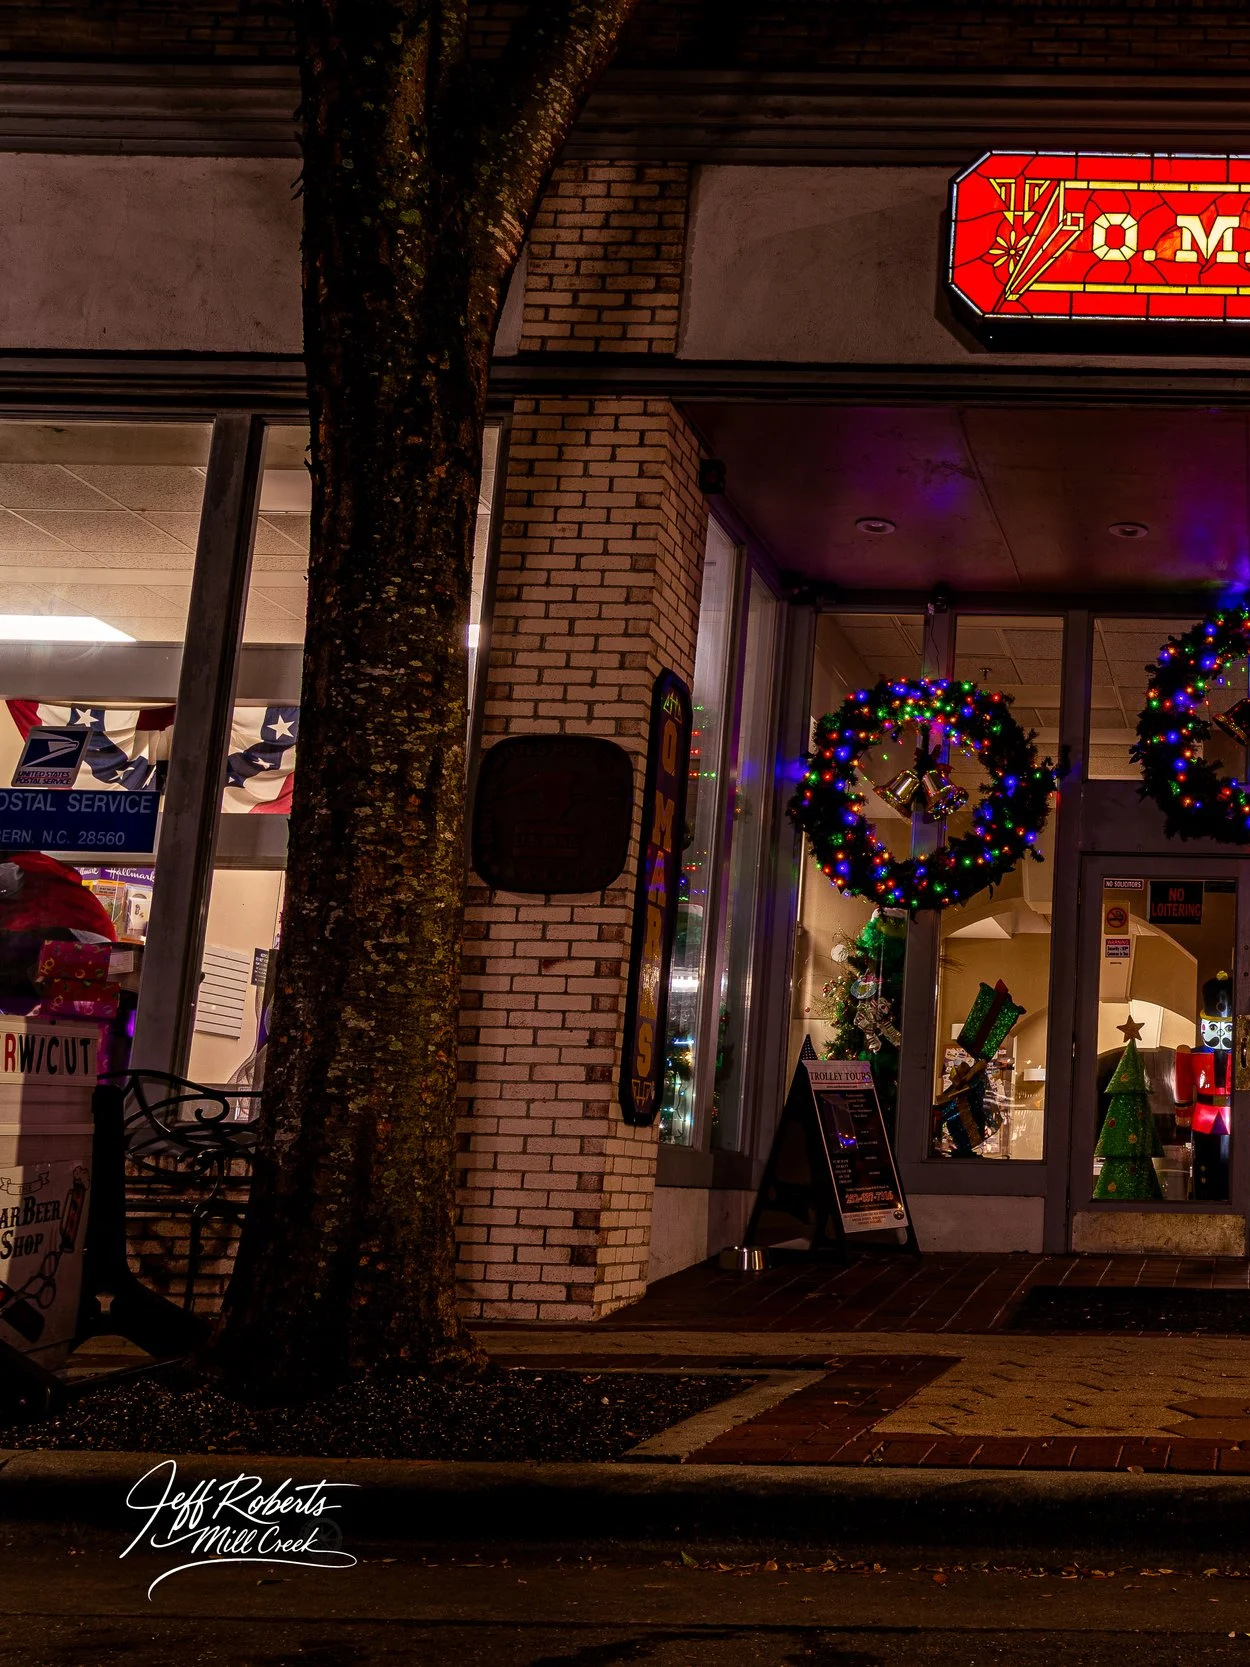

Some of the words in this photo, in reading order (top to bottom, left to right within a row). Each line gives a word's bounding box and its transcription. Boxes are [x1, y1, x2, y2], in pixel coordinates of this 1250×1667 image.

[1093, 213, 1156, 262] O.
[66, 793, 153, 813] SERVICE
[42, 830, 70, 844] N.C.
[77, 831, 126, 845] 28560
[1168, 888, 1184, 901] NO
[1151, 903, 1201, 917] LOITERING
[810, 1072, 843, 1081] TROLLEY
[845, 1072, 872, 1081] TOURS
